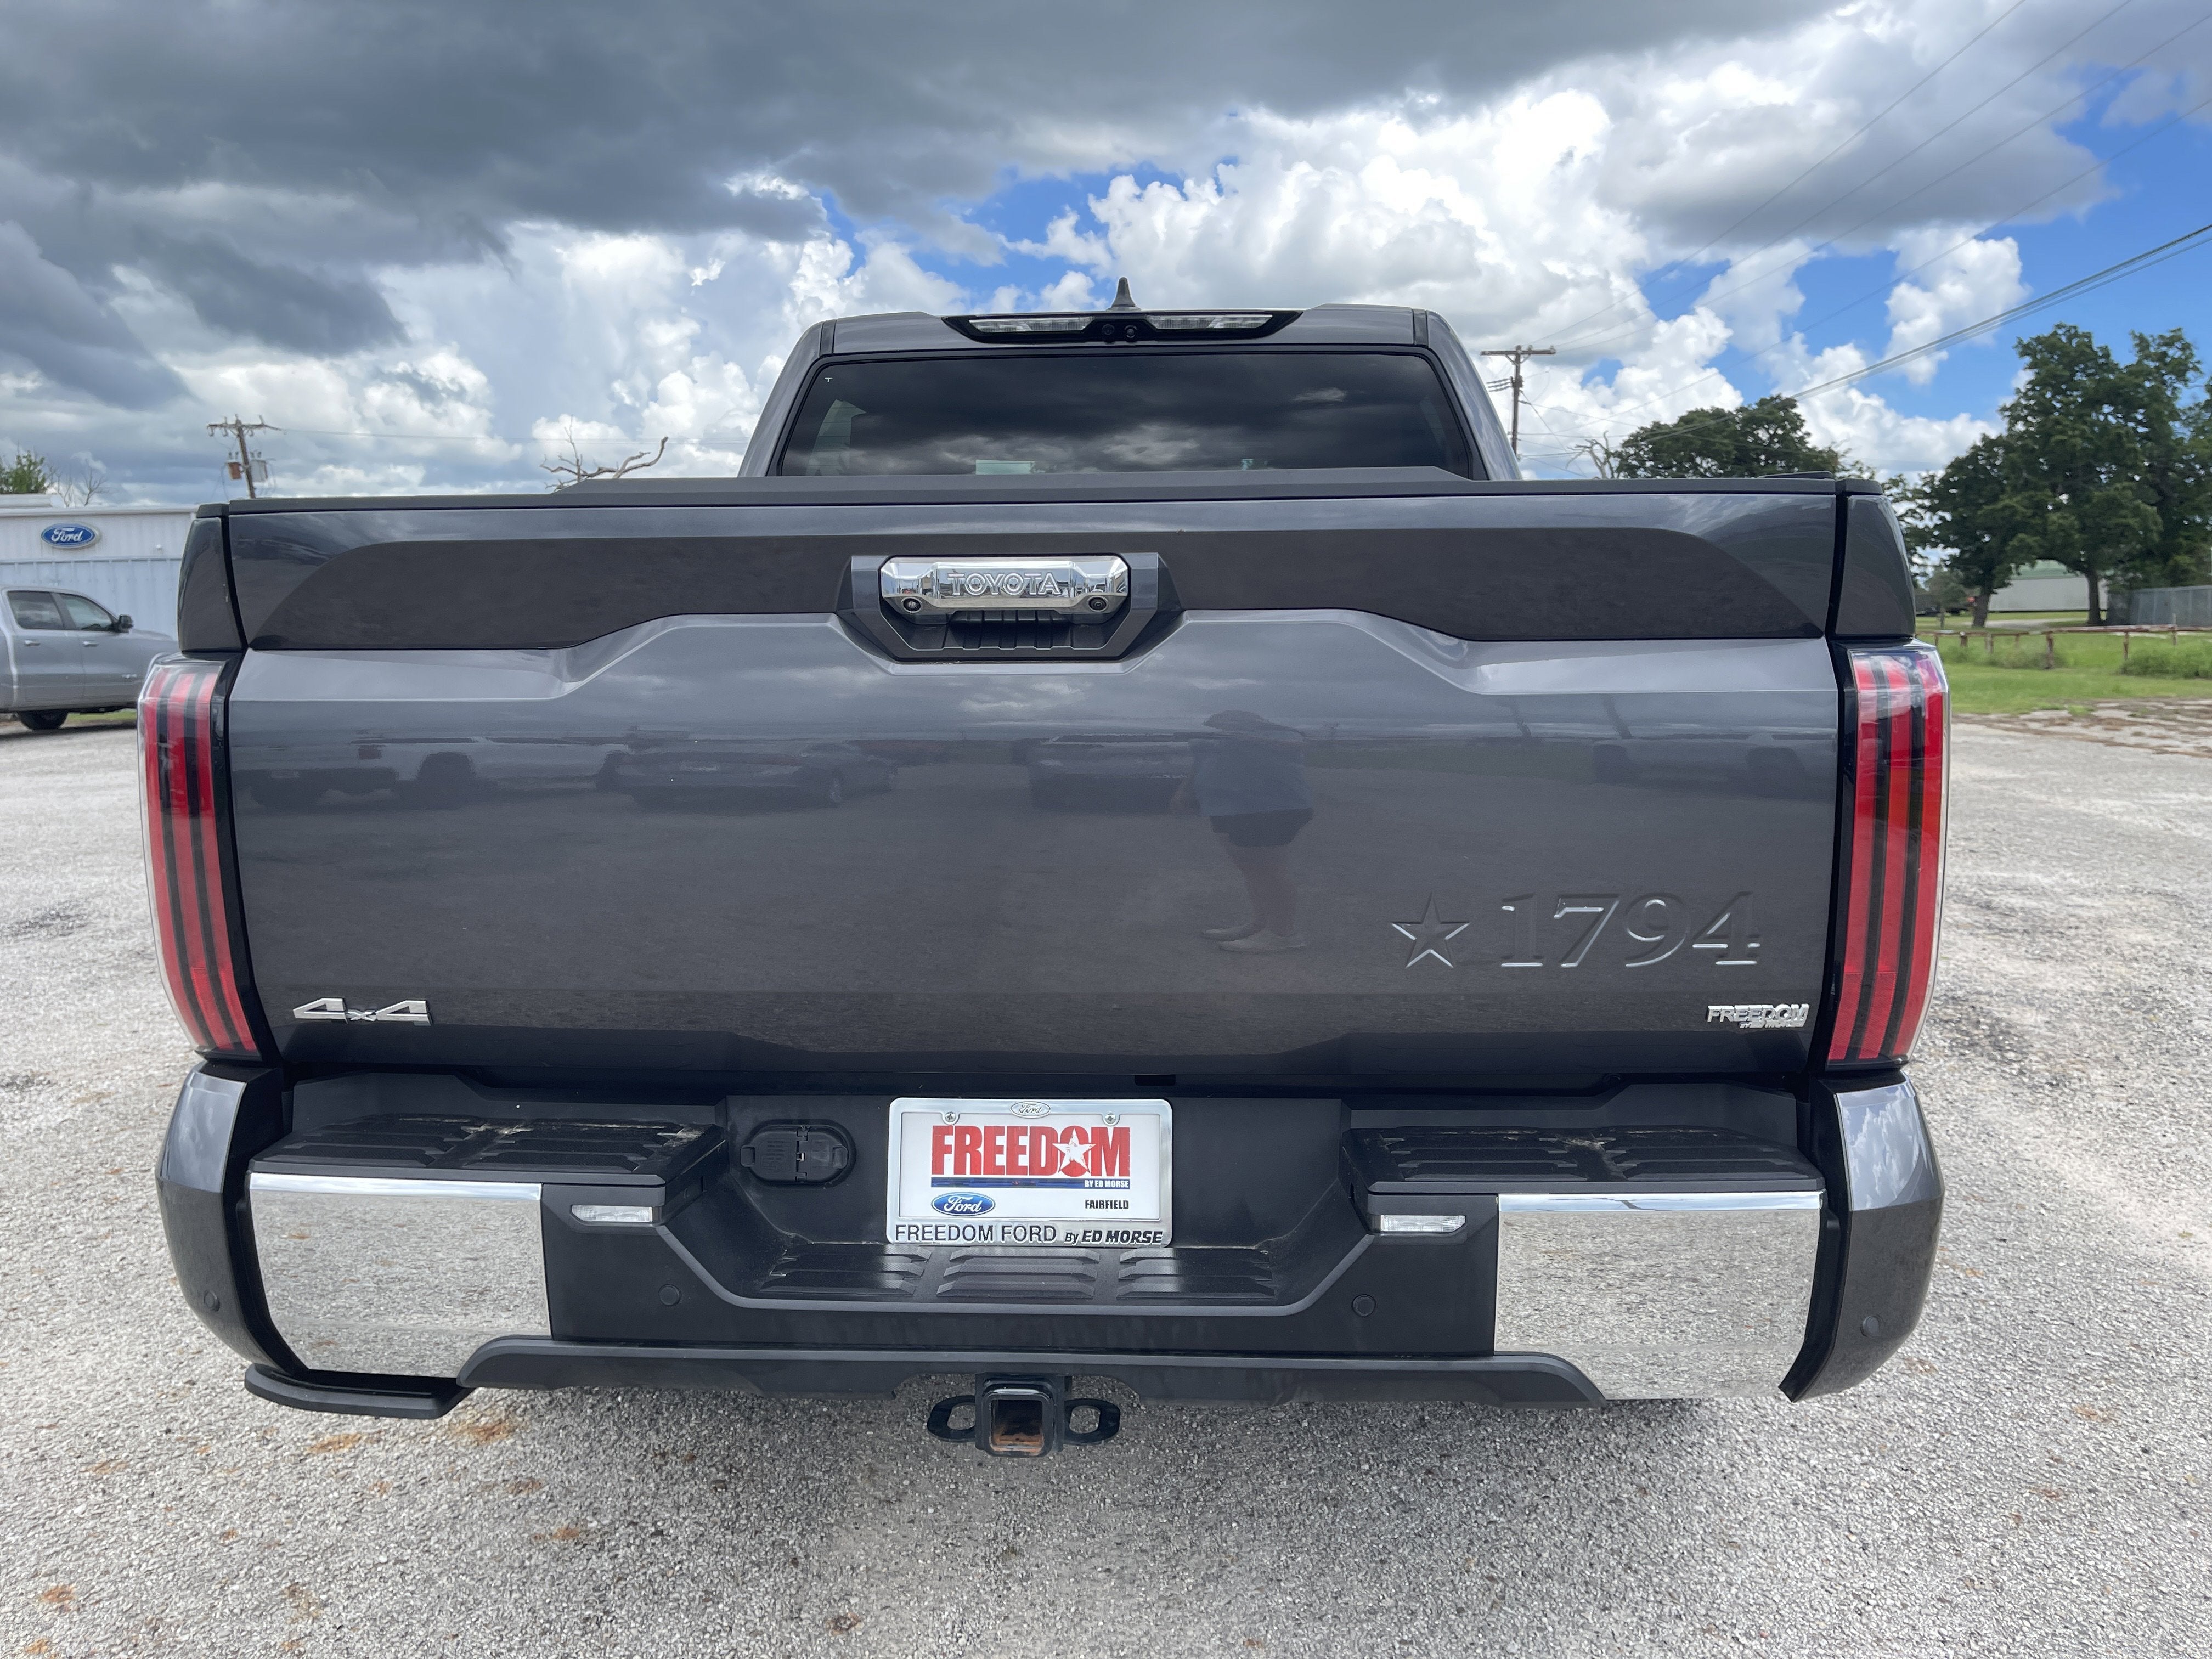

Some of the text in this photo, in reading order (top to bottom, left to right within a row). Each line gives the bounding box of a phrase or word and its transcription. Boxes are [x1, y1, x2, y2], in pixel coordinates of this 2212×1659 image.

[51, 527, 83, 542] Ford
[947, 573, 1062, 596] TOYOTA
[1500, 892, 1760, 967] 1794
[292, 997, 432, 1026] 4x4
[1706, 1003, 1809, 1022] FREEDOM
[1019, 1103, 1042, 1114] Ford
[931, 1125, 1130, 1177] FREEDOM
[1084, 1180, 1093, 1188] BY
[1104, 1180, 1129, 1188] MORSE
[944, 1196, 983, 1212] Ford
[1085, 1200, 1129, 1209] FAIRFIELD
[895, 1224, 1163, 1245] FREEDOM FORD By ED MORSE
